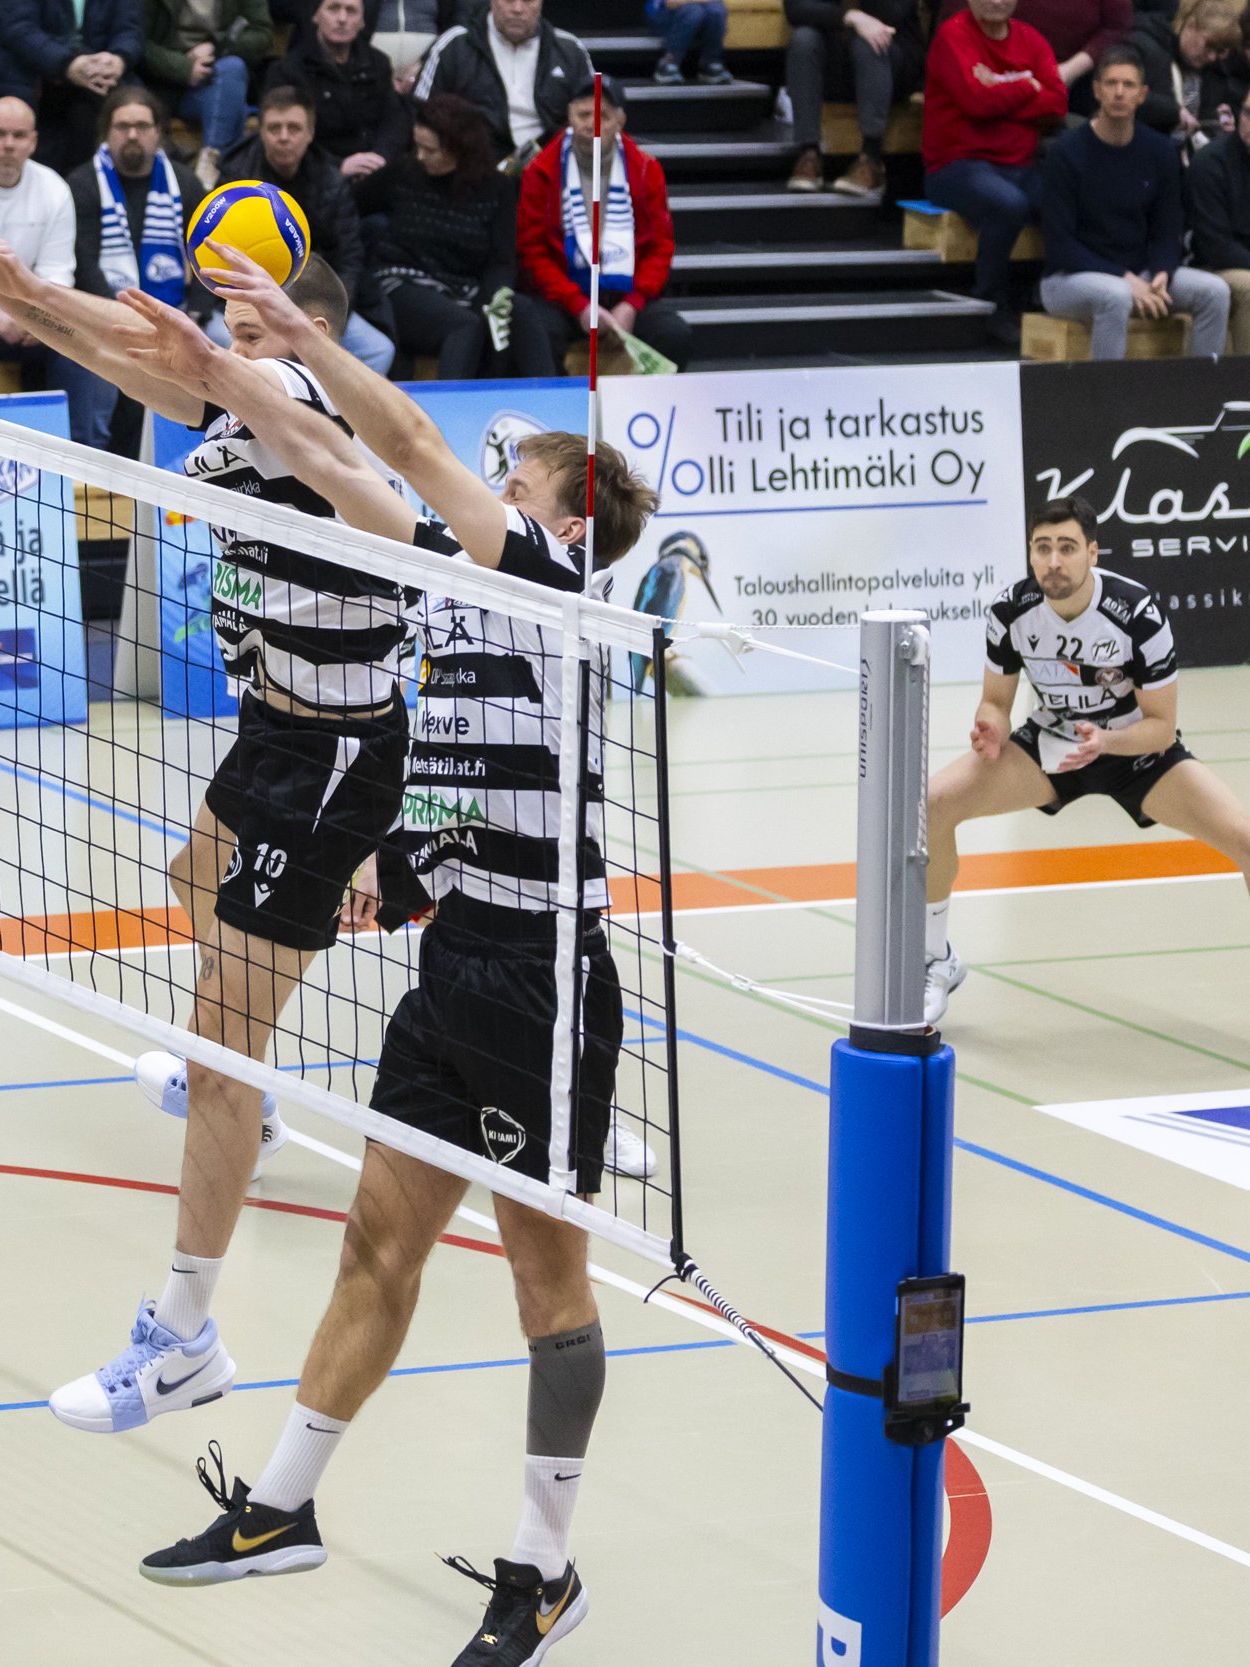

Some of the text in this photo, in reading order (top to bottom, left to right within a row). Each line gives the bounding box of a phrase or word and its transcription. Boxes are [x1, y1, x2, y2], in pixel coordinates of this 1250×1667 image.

[203, 196, 227, 224] V200W
[284, 218, 305, 258] MIKASA
[716, 402, 763, 443] Tili
[777, 408, 811, 451] ja
[825, 398, 985, 440] tarkastus
[752, 449, 917, 494] Lehtimäki
[931, 449, 986, 495] Oy
[16, 520, 44, 564] ja
[734, 565, 996, 598] Taloushallintopalveluita yli
[752, 609, 777, 626] 30
[786, 606, 858, 627] vuoden
[1056, 633, 1085, 663] 22
[421, 709, 471, 736] Vexve
[402, 792, 488, 827] PRISMA
[253, 842, 288, 879] 10
